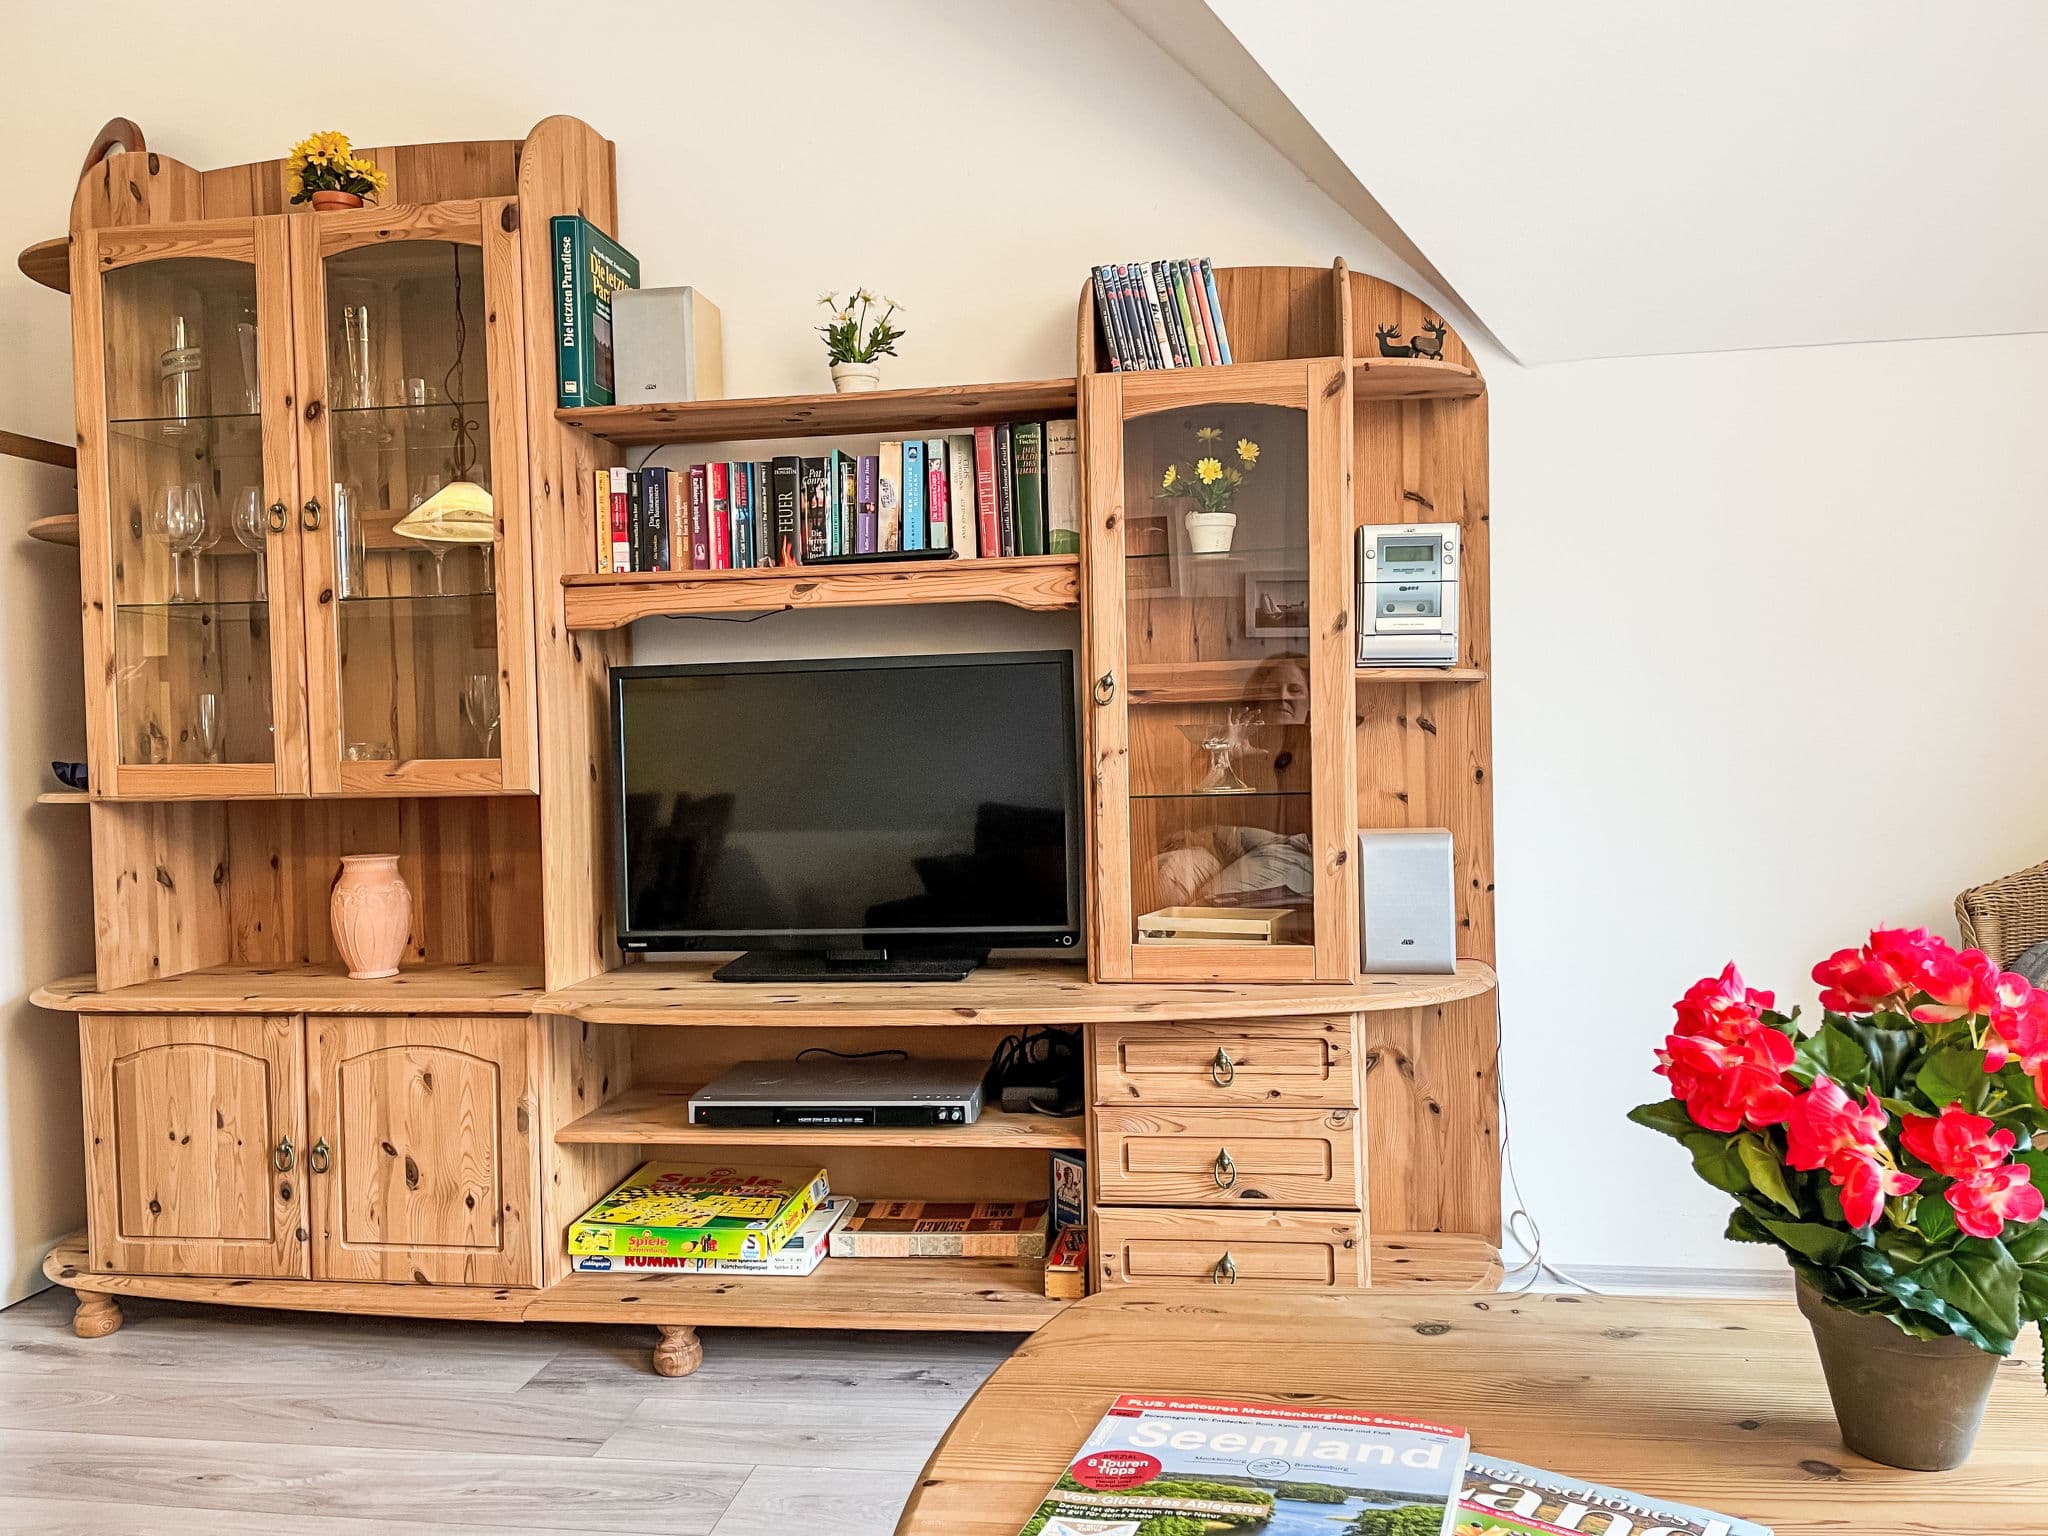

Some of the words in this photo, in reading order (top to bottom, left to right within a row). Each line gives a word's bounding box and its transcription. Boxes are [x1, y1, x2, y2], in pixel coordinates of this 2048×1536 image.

[561, 236, 573, 289] Paradiese
[590, 253, 606, 281] Die
[563, 291, 574, 327] letzten
[563, 327, 575, 347] Die
[778, 491, 794, 532] FEUER
[811, 529, 822, 537] Die
[628, 1235, 669, 1248] Spiele
[1127, 1399, 1166, 1407] PLUS:
[1169, 1401, 1239, 1413] Radtouren
[1241, 1407, 1371, 1423] Mecklenburgische
[1373, 1417, 1454, 1434] Seenplatte
[1128, 1420, 1444, 1470] Seenland
[1088, 1458, 1098, 1467] 8
[1100, 1458, 1149, 1468] Touren
[1098, 1465, 1136, 1476] Tipps
[1058, 1502, 1088, 1511] Darum
[1193, 1511, 1222, 1519] Natur
[1063, 1491, 1098, 1503] Vom
[1101, 1494, 1147, 1506] Glück
[1151, 1497, 1181, 1507] des
[1183, 1499, 1263, 1514] Ablegens
[1544, 1484, 1689, 1526] schönes
